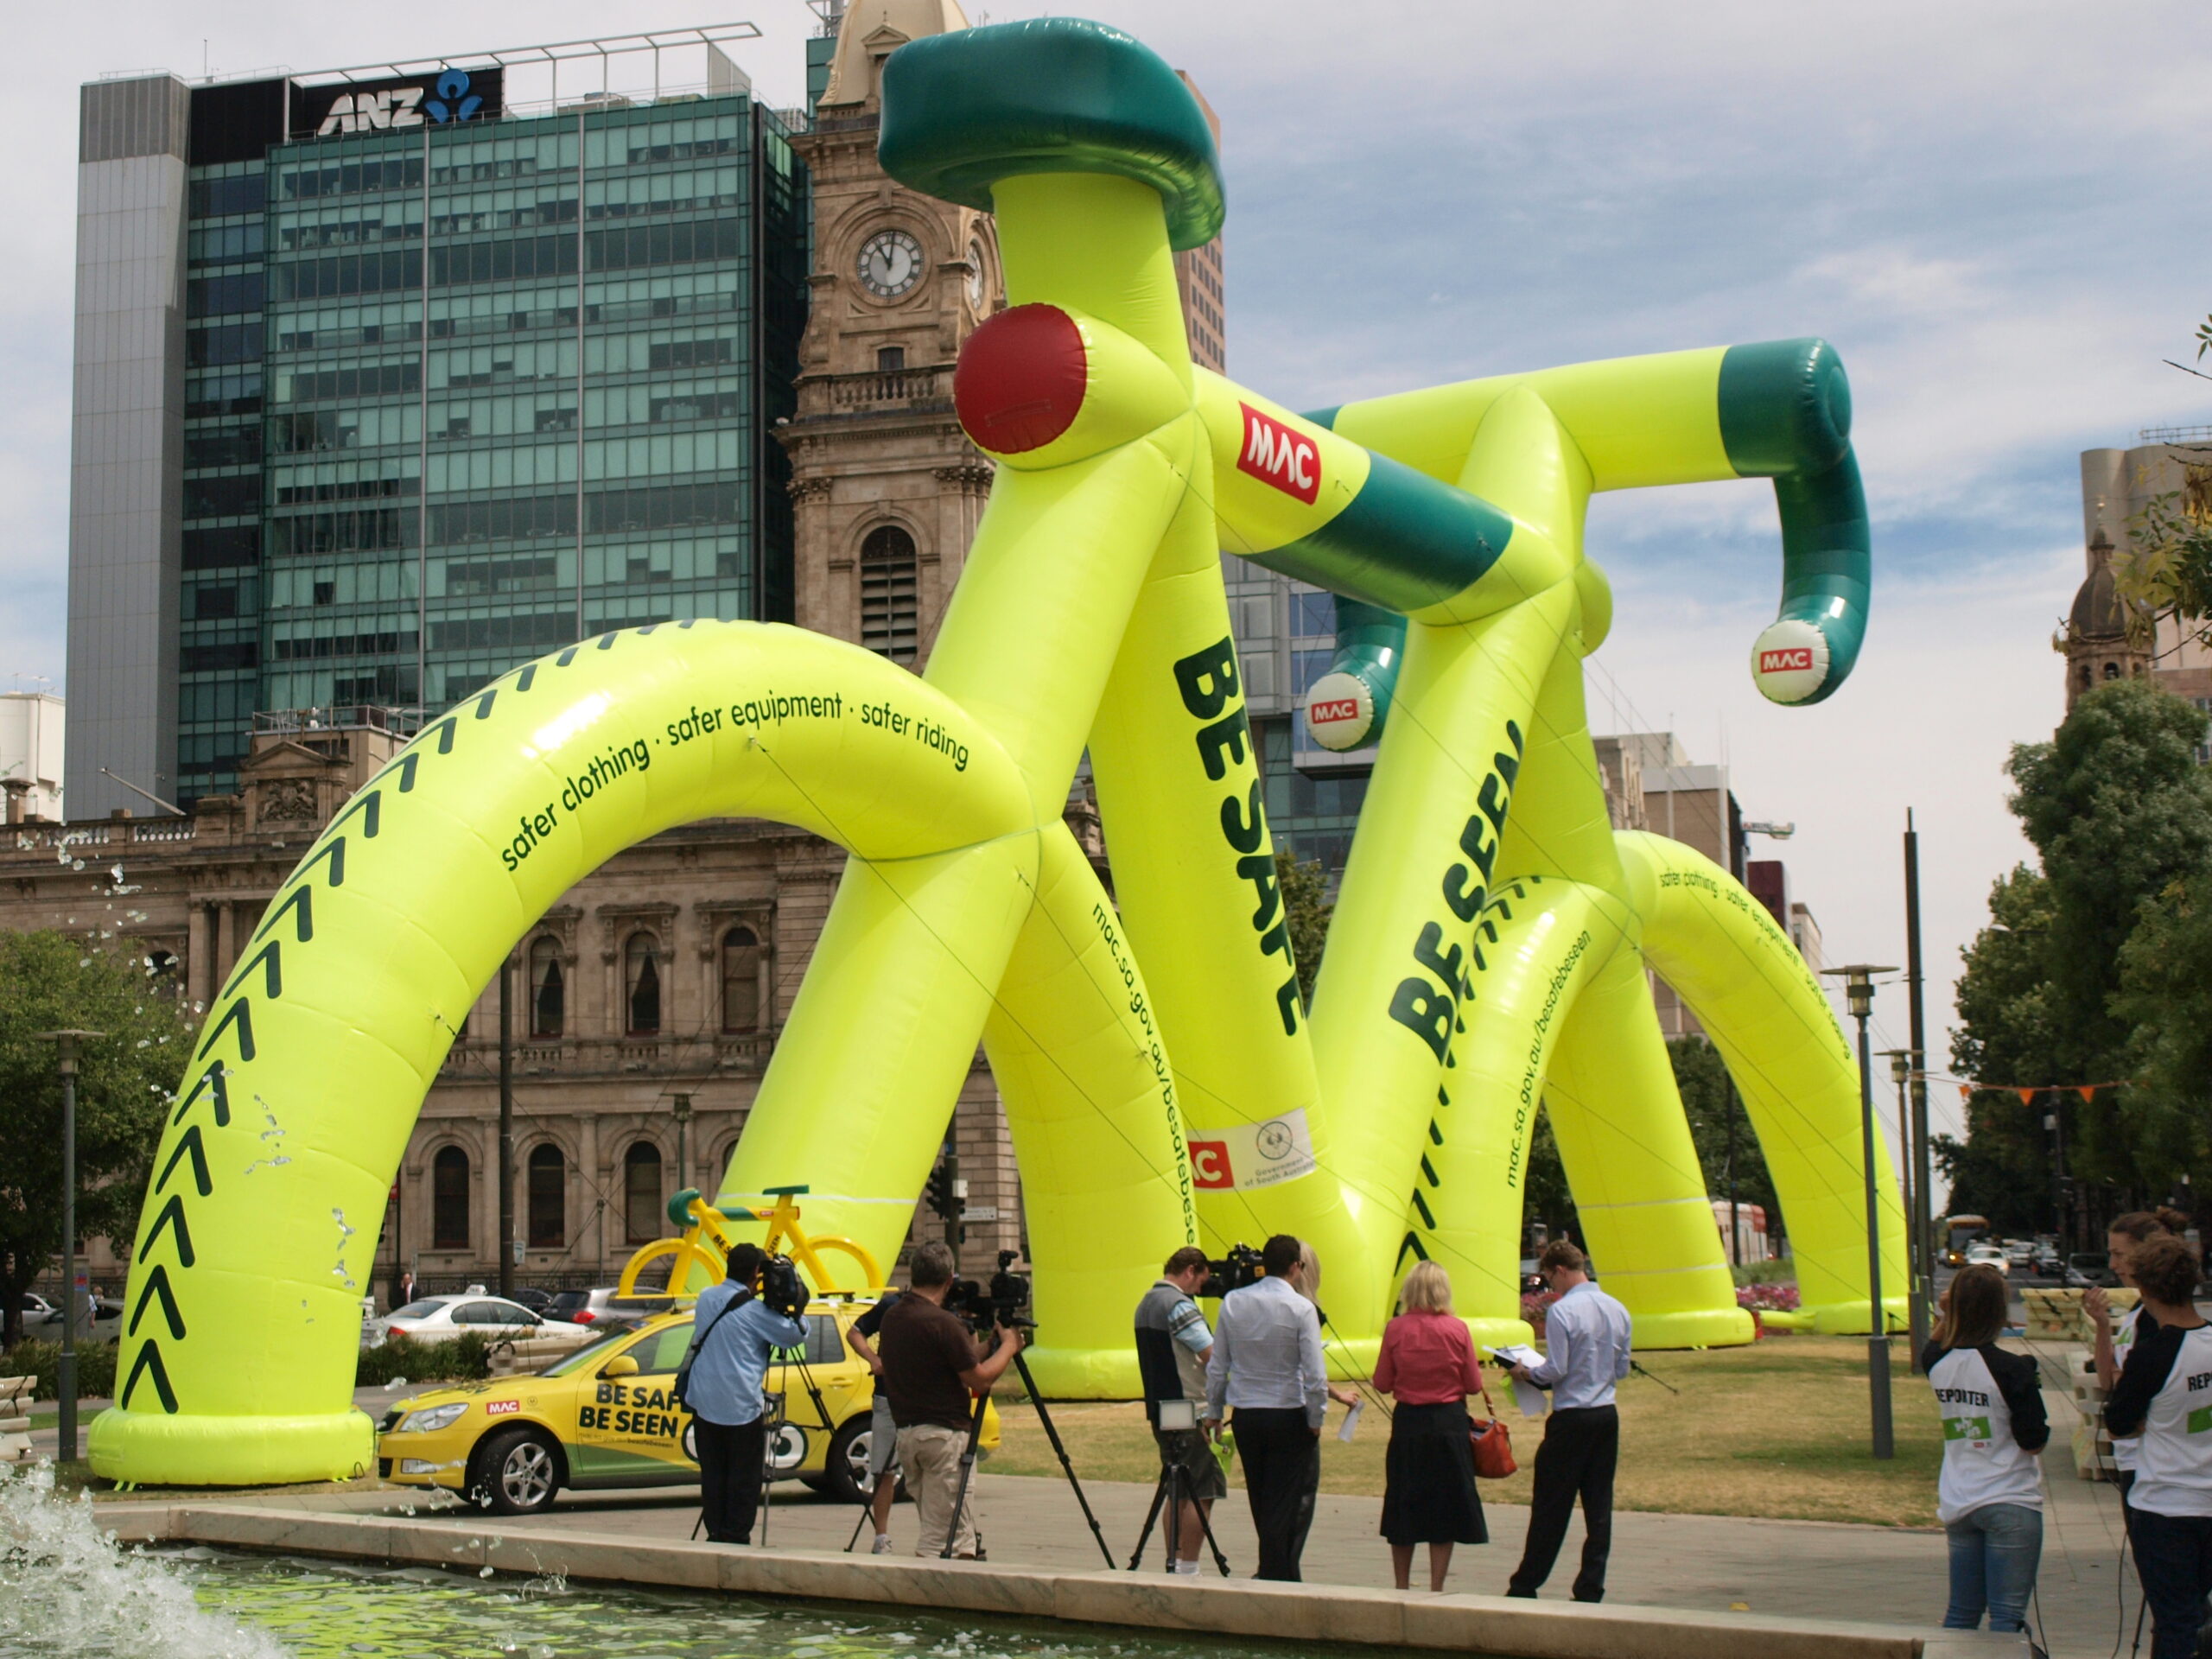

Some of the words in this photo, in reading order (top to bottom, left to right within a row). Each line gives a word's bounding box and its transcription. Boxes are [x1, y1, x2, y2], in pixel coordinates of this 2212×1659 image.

[317, 87, 424, 136] ANZ
[1247, 416, 1314, 490] MAC
[1763, 651, 1808, 671] MAC
[1173, 635, 1253, 781] BE
[1314, 702, 1355, 721] MAC
[501, 801, 560, 872] safer
[561, 737, 652, 813] clothing
[666, 703, 724, 747] safer
[730, 690, 842, 730] equipment
[861, 700, 912, 736] safer
[916, 717, 969, 772] riding
[1388, 921, 1470, 1067] BE
[1091, 901, 1195, 1245] mac.sa.gov.au/besafebese
[596, 1383, 628, 1406] BE
[632, 1386, 683, 1412] SAF
[2187, 1372, 2212, 1392] REP
[488, 1402, 518, 1414] MAC
[579, 1406, 612, 1430] BE
[614, 1410, 679, 1439] SEEN
